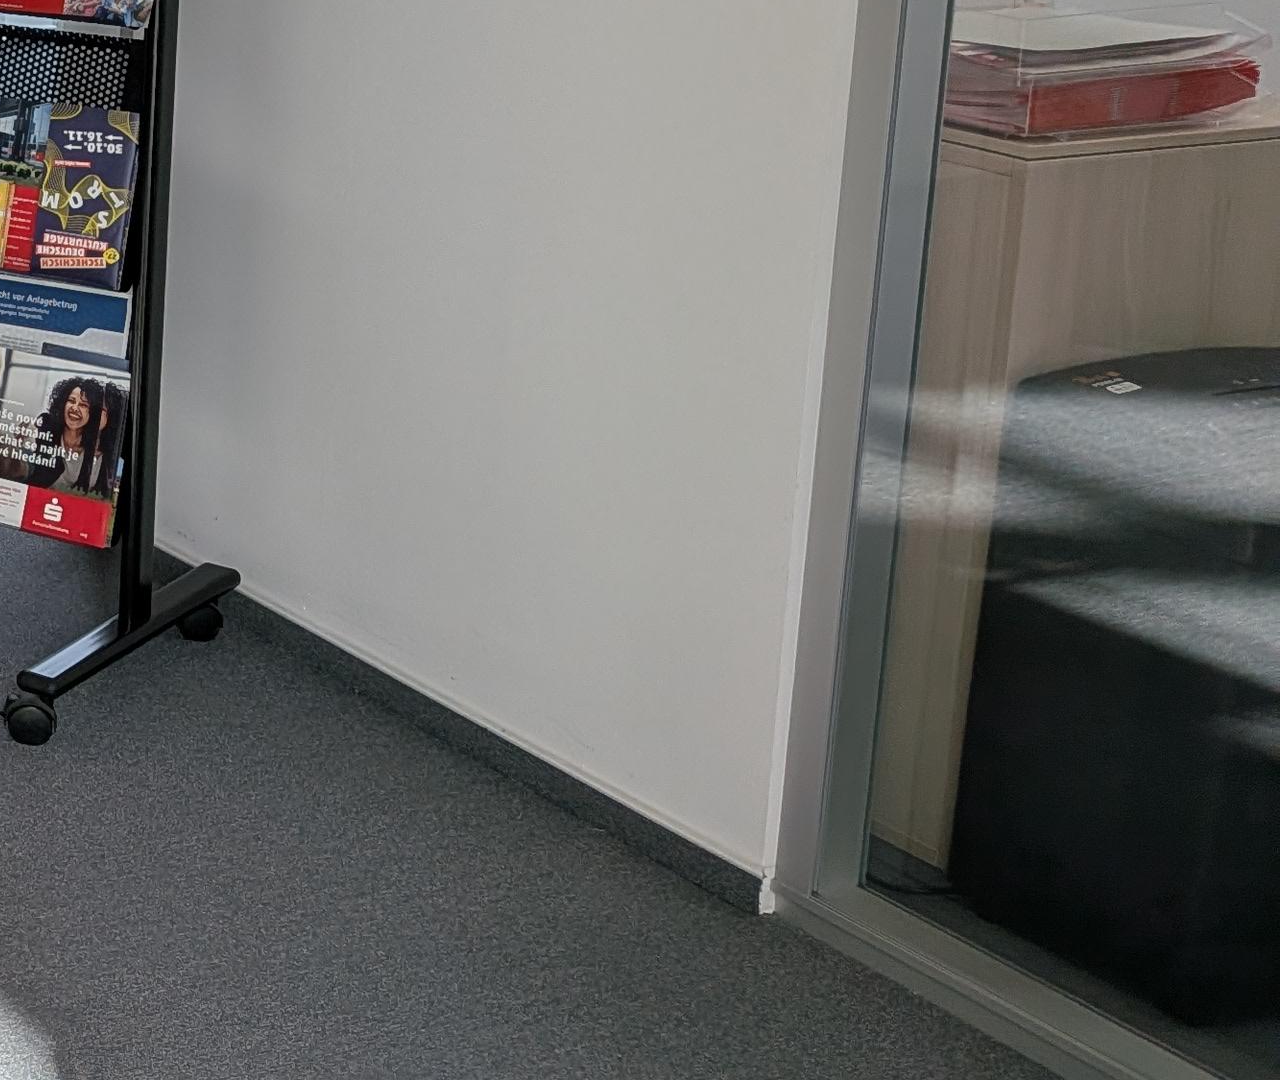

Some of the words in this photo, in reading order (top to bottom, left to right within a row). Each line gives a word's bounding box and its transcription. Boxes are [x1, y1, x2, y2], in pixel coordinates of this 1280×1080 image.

[64, 130, 103, 141] 16.11.
[84, 142, 123, 154] 30.10.
[43, 233, 108, 251] KULTURTAGE
[36, 245, 85, 256] DEUTSCHE
[42, 258, 104, 267] TSCHECHISCH
[12, 293, 25, 301] vor
[26, 294, 78, 311] Anlagebetrug
[17, 414, 43, 427] nové
[24, 441, 37, 451] se
[40, 445, 66, 458] najít
[67, 448, 79, 461] je
[11, 448, 57, 469] hledání!
